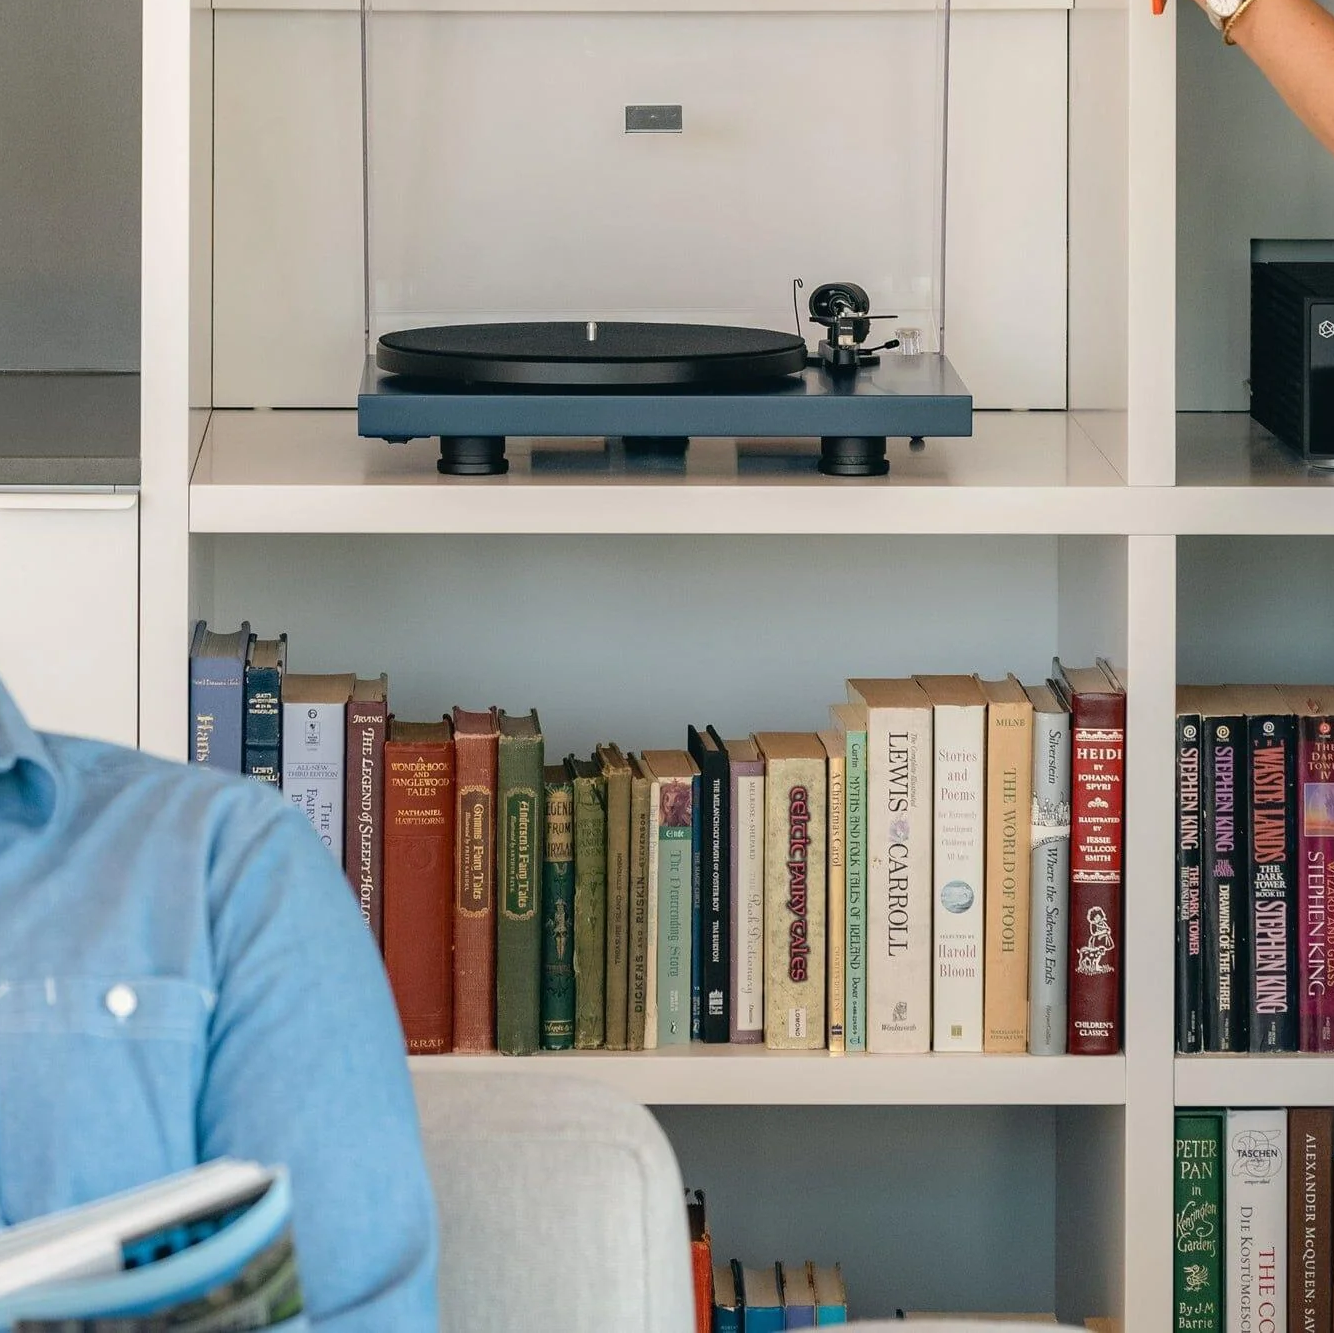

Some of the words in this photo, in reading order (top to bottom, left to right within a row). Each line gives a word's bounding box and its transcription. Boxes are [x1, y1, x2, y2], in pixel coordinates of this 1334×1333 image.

[352, 715, 383, 724] IRVING
[996, 719, 1026, 727] MILNE
[938, 749, 977, 763] Stories
[1048, 729, 1062, 784] Silverstein
[1077, 748, 1122, 760] HEIDI
[887, 732, 909, 813] LEWIS
[947, 768, 968, 782] and
[1002, 768, 1017, 803] THE
[1078, 774, 1119, 783] JOHANNA
[1180, 747, 1199, 811] STEPHEN
[1215, 747, 1234, 812] STEPHEN
[1253, 745, 1285, 804] WASTE
[940, 787, 975, 801] Poems
[1085, 783, 1111, 791] SPYRI
[1002, 808, 1016, 873] WORLD
[1180, 813, 1199, 850] KING
[1215, 815, 1235, 852] KING
[1253, 808, 1286, 863] LANDS
[1046, 847, 1059, 883] Where
[887, 844, 909, 957] CARROLL
[1001, 877, 1015, 902] OF
[1046, 885, 1057, 903] the
[1001, 905, 1015, 953] POOH
[1045, 907, 1060, 955] Sidewalk
[938, 944, 977, 959] Harold
[939, 964, 975, 978] Bloom
[1044, 956, 1057, 985] Ends
[1074, 1021, 1114, 1029] CHILDREN'S
[1176, 1139, 1217, 1159] PETER
[1237, 1150, 1278, 1158] TASCHEN
[1181, 1162, 1212, 1180] PAN
[1305, 1133, 1317, 1223] ALEXANDER
